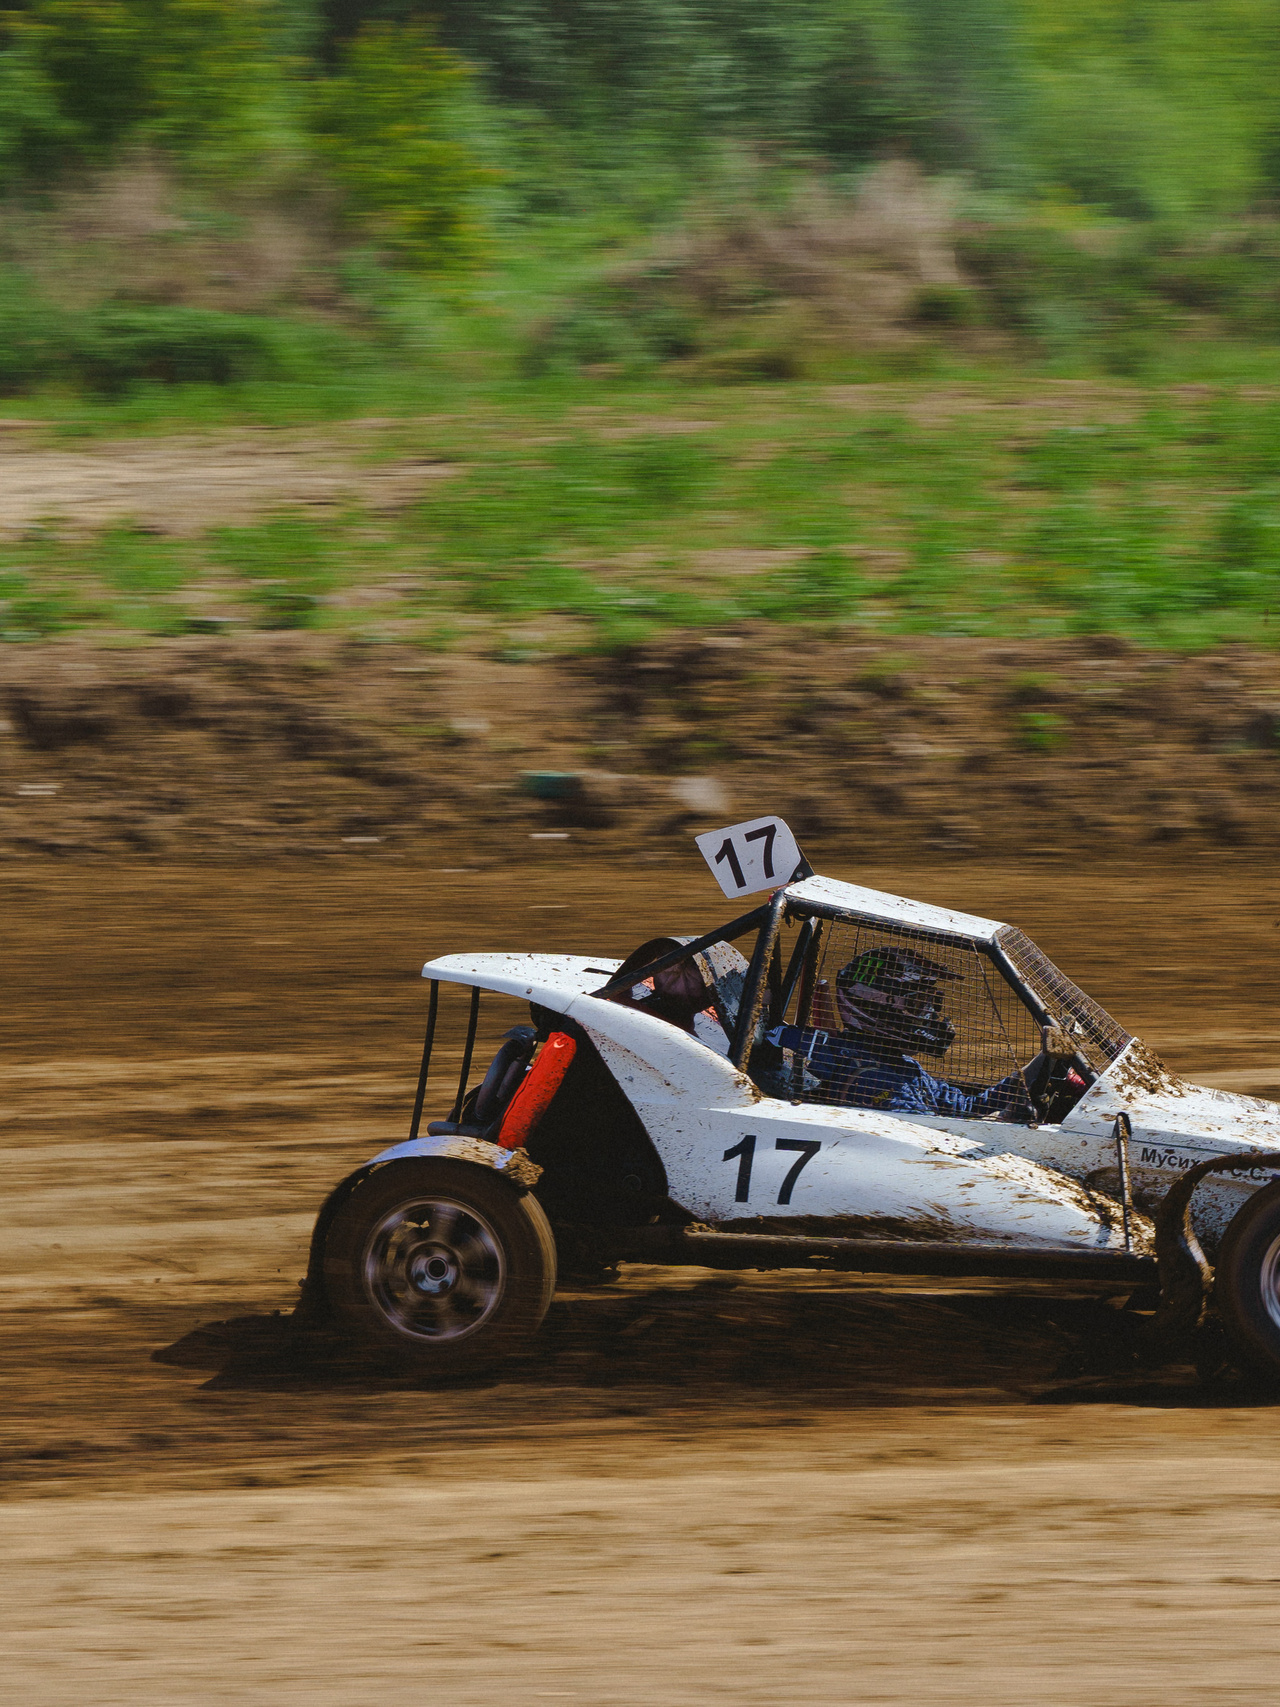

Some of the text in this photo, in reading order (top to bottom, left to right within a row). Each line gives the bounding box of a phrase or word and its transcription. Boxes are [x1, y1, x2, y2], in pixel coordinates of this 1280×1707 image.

[715, 824, 777, 889] 17
[721, 1135, 822, 1205] 17
[1140, 1147, 1224, 1176] Мусих
